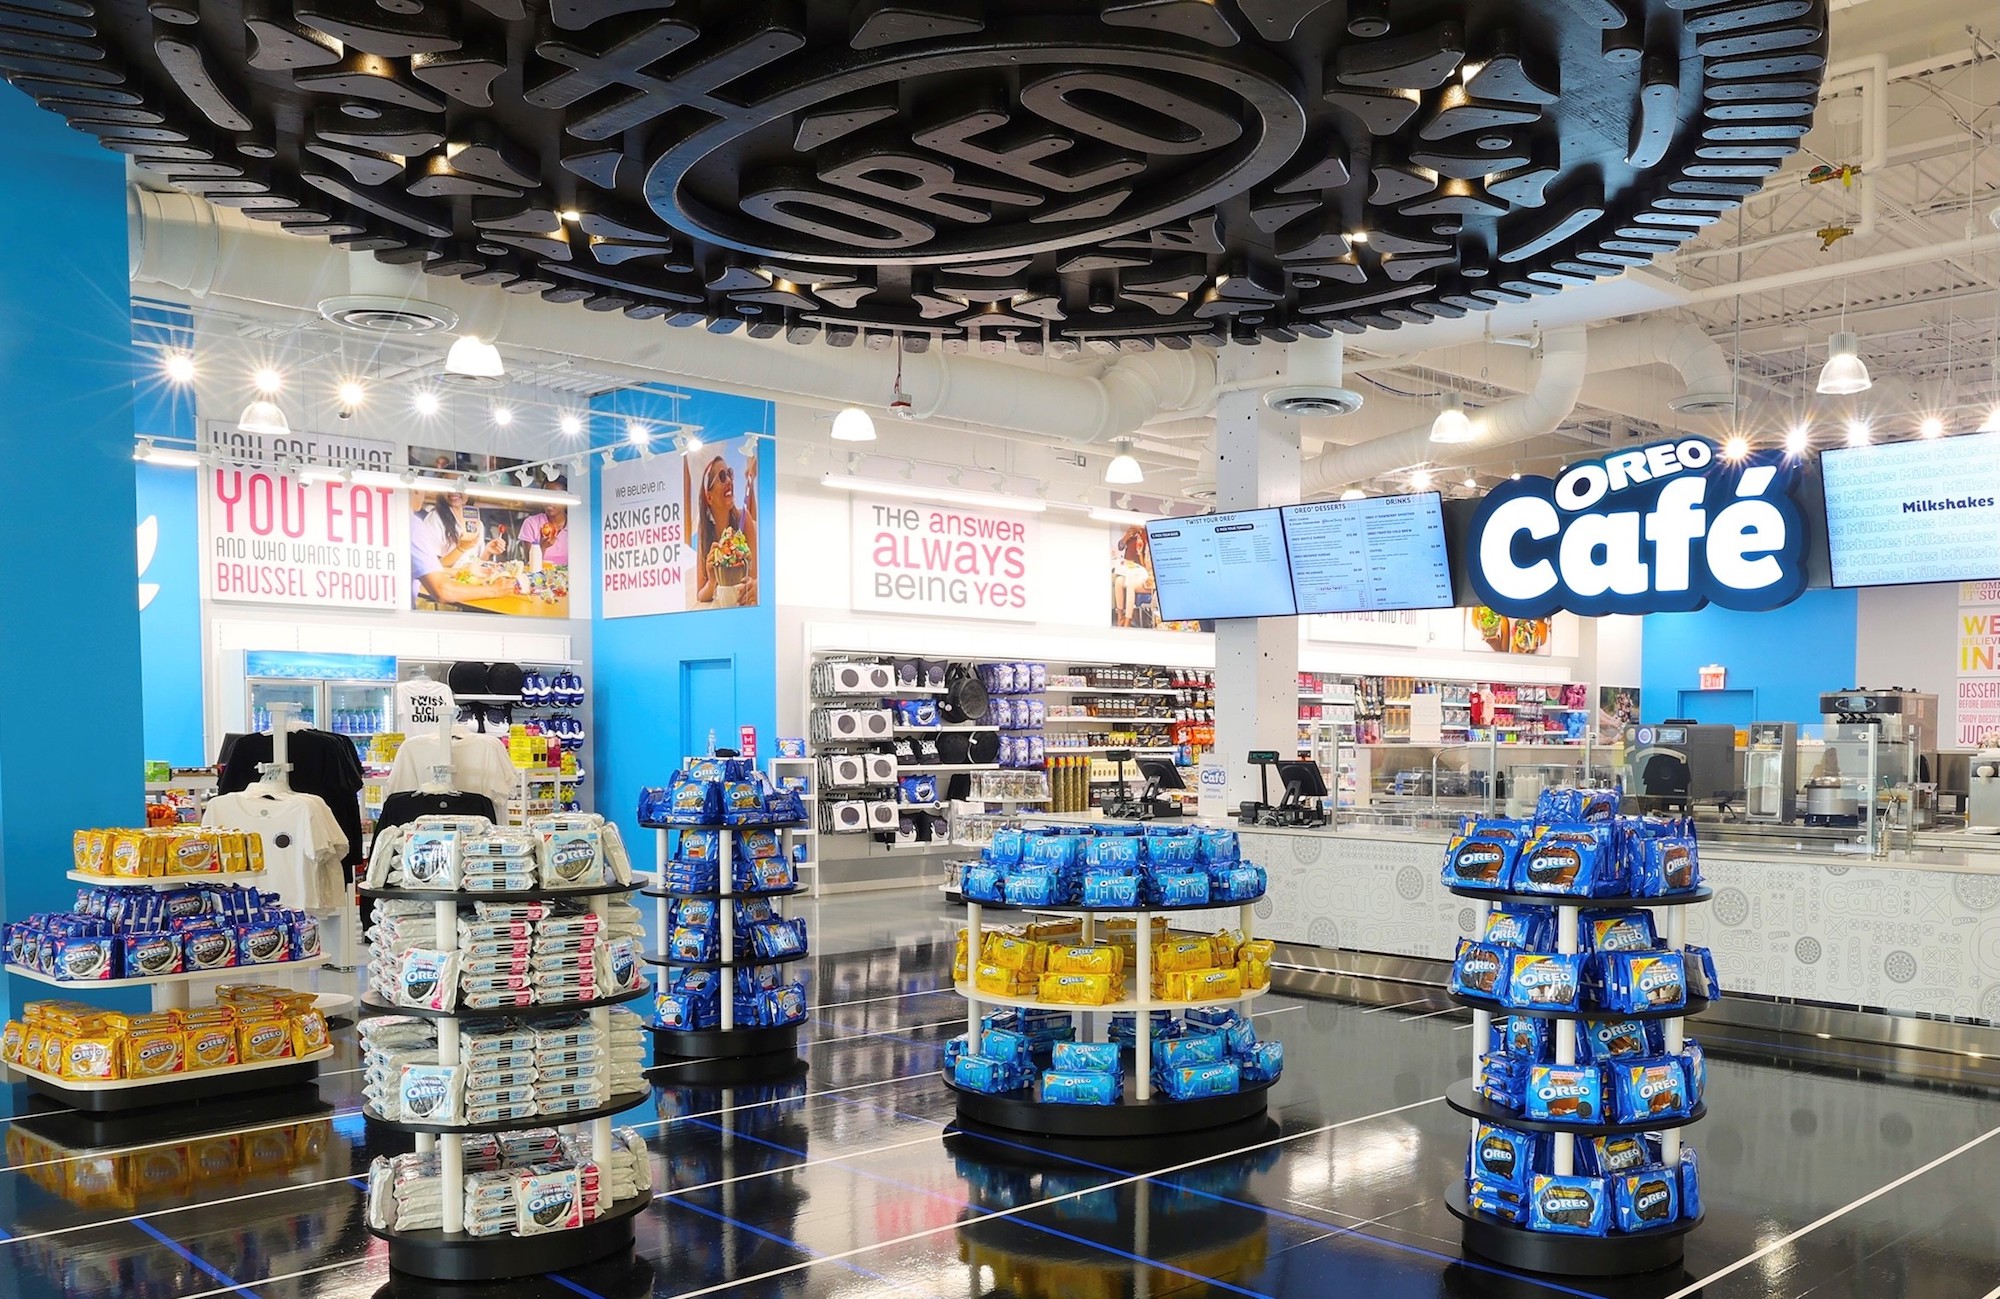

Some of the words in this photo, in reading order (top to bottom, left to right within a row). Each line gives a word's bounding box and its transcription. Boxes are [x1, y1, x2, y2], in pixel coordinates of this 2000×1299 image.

[739, 72, 1244, 248] OREO
[1555, 439, 1711, 511] OREO
[216, 468, 305, 538] YOU
[326, 481, 395, 548] EAT
[1315, 503, 1346, 512] DESSERTS
[1385, 498, 1411, 506] DRINKS
[1903, 497, 1994, 513] Milkshakes
[604, 507, 650, 531] ASKING
[654, 502, 680, 524] FOR
[1202, 516, 1218, 524] YOUR
[604, 524, 681, 549] FORGIVENESS
[1480, 465, 1786, 600] Café
[216, 537, 246, 559] AND
[252, 540, 286, 562] WHO
[292, 543, 340, 567] WANTS
[346, 548, 361, 568] TO
[366, 550, 382, 570] BE
[387, 552, 395, 571] A
[605, 547, 659, 570] INSTEAD
[663, 544, 681, 564] OF
[217, 562, 308, 597] BRUSSEL
[316, 571, 396, 604] SPROUT!
[605, 566, 681, 591] PERMISSION
[1962, 615, 2000, 636] WE
[693, 769, 720, 778] OREO
[1202, 770, 1225, 784] Café
[676, 790, 704, 800] OREO
[731, 789, 758, 800] OREO
[685, 839, 705, 848] OREO
[749, 838, 773, 849] OREO
[1100, 840, 1126, 849] OREO
[1168, 840, 1189, 848] OREO
[115, 846, 133, 856] OREO
[177, 843, 210, 857] OREO
[552, 850, 595, 865] OREO
[1459, 852, 1500, 867] OREO
[1532, 856, 1575, 871] OREO
[762, 866, 785, 877] OREO
[1666, 858, 1689, 874] OREO
[1100, 878, 1125, 887] OREO
[1178, 877, 1200, 886] OREO
[169, 901, 200, 913] OREO
[684, 905, 709, 914] OREO
[247, 935, 278, 947] OREO
[1490, 930, 1519, 942] OREO
[1604, 933, 1644, 950] OREO
[192, 940, 224, 952] OREO
[64, 950, 98, 962] OREO
[136, 947, 170, 959] OREO
[612, 957, 635, 971] OREO
[1464, 961, 1496, 973] OREO
[406, 971, 439, 983] OREO
[1059, 977, 1085, 985] OREO
[1521, 973, 1571, 986] OREO
[1640, 972, 1679, 990] OREO
[660, 1007, 682, 1015] OREO
[1511, 1021, 1533, 1032] OREO
[1598, 1023, 1637, 1042] OREO
[251, 1030, 282, 1044] OREO
[197, 1037, 228, 1051] OREO
[1076, 1046, 1102, 1054] OREO
[1185, 1039, 1208, 1049] OREO
[139, 1043, 174, 1059] OREO
[1201, 1069, 1224, 1080] OREO
[1065, 1078, 1091, 1087] OREO
[1640, 1078, 1678, 1098] OREO
[407, 1086, 447, 1099] OREO
[1538, 1086, 1590, 1099] OREO
[1483, 1150, 1512, 1161] OREO
[1609, 1149, 1640, 1166] OREO
[528, 1191, 574, 1212] OREO
[1545, 1199, 1589, 1211] OREO
[1638, 1190, 1668, 1209] OREO
